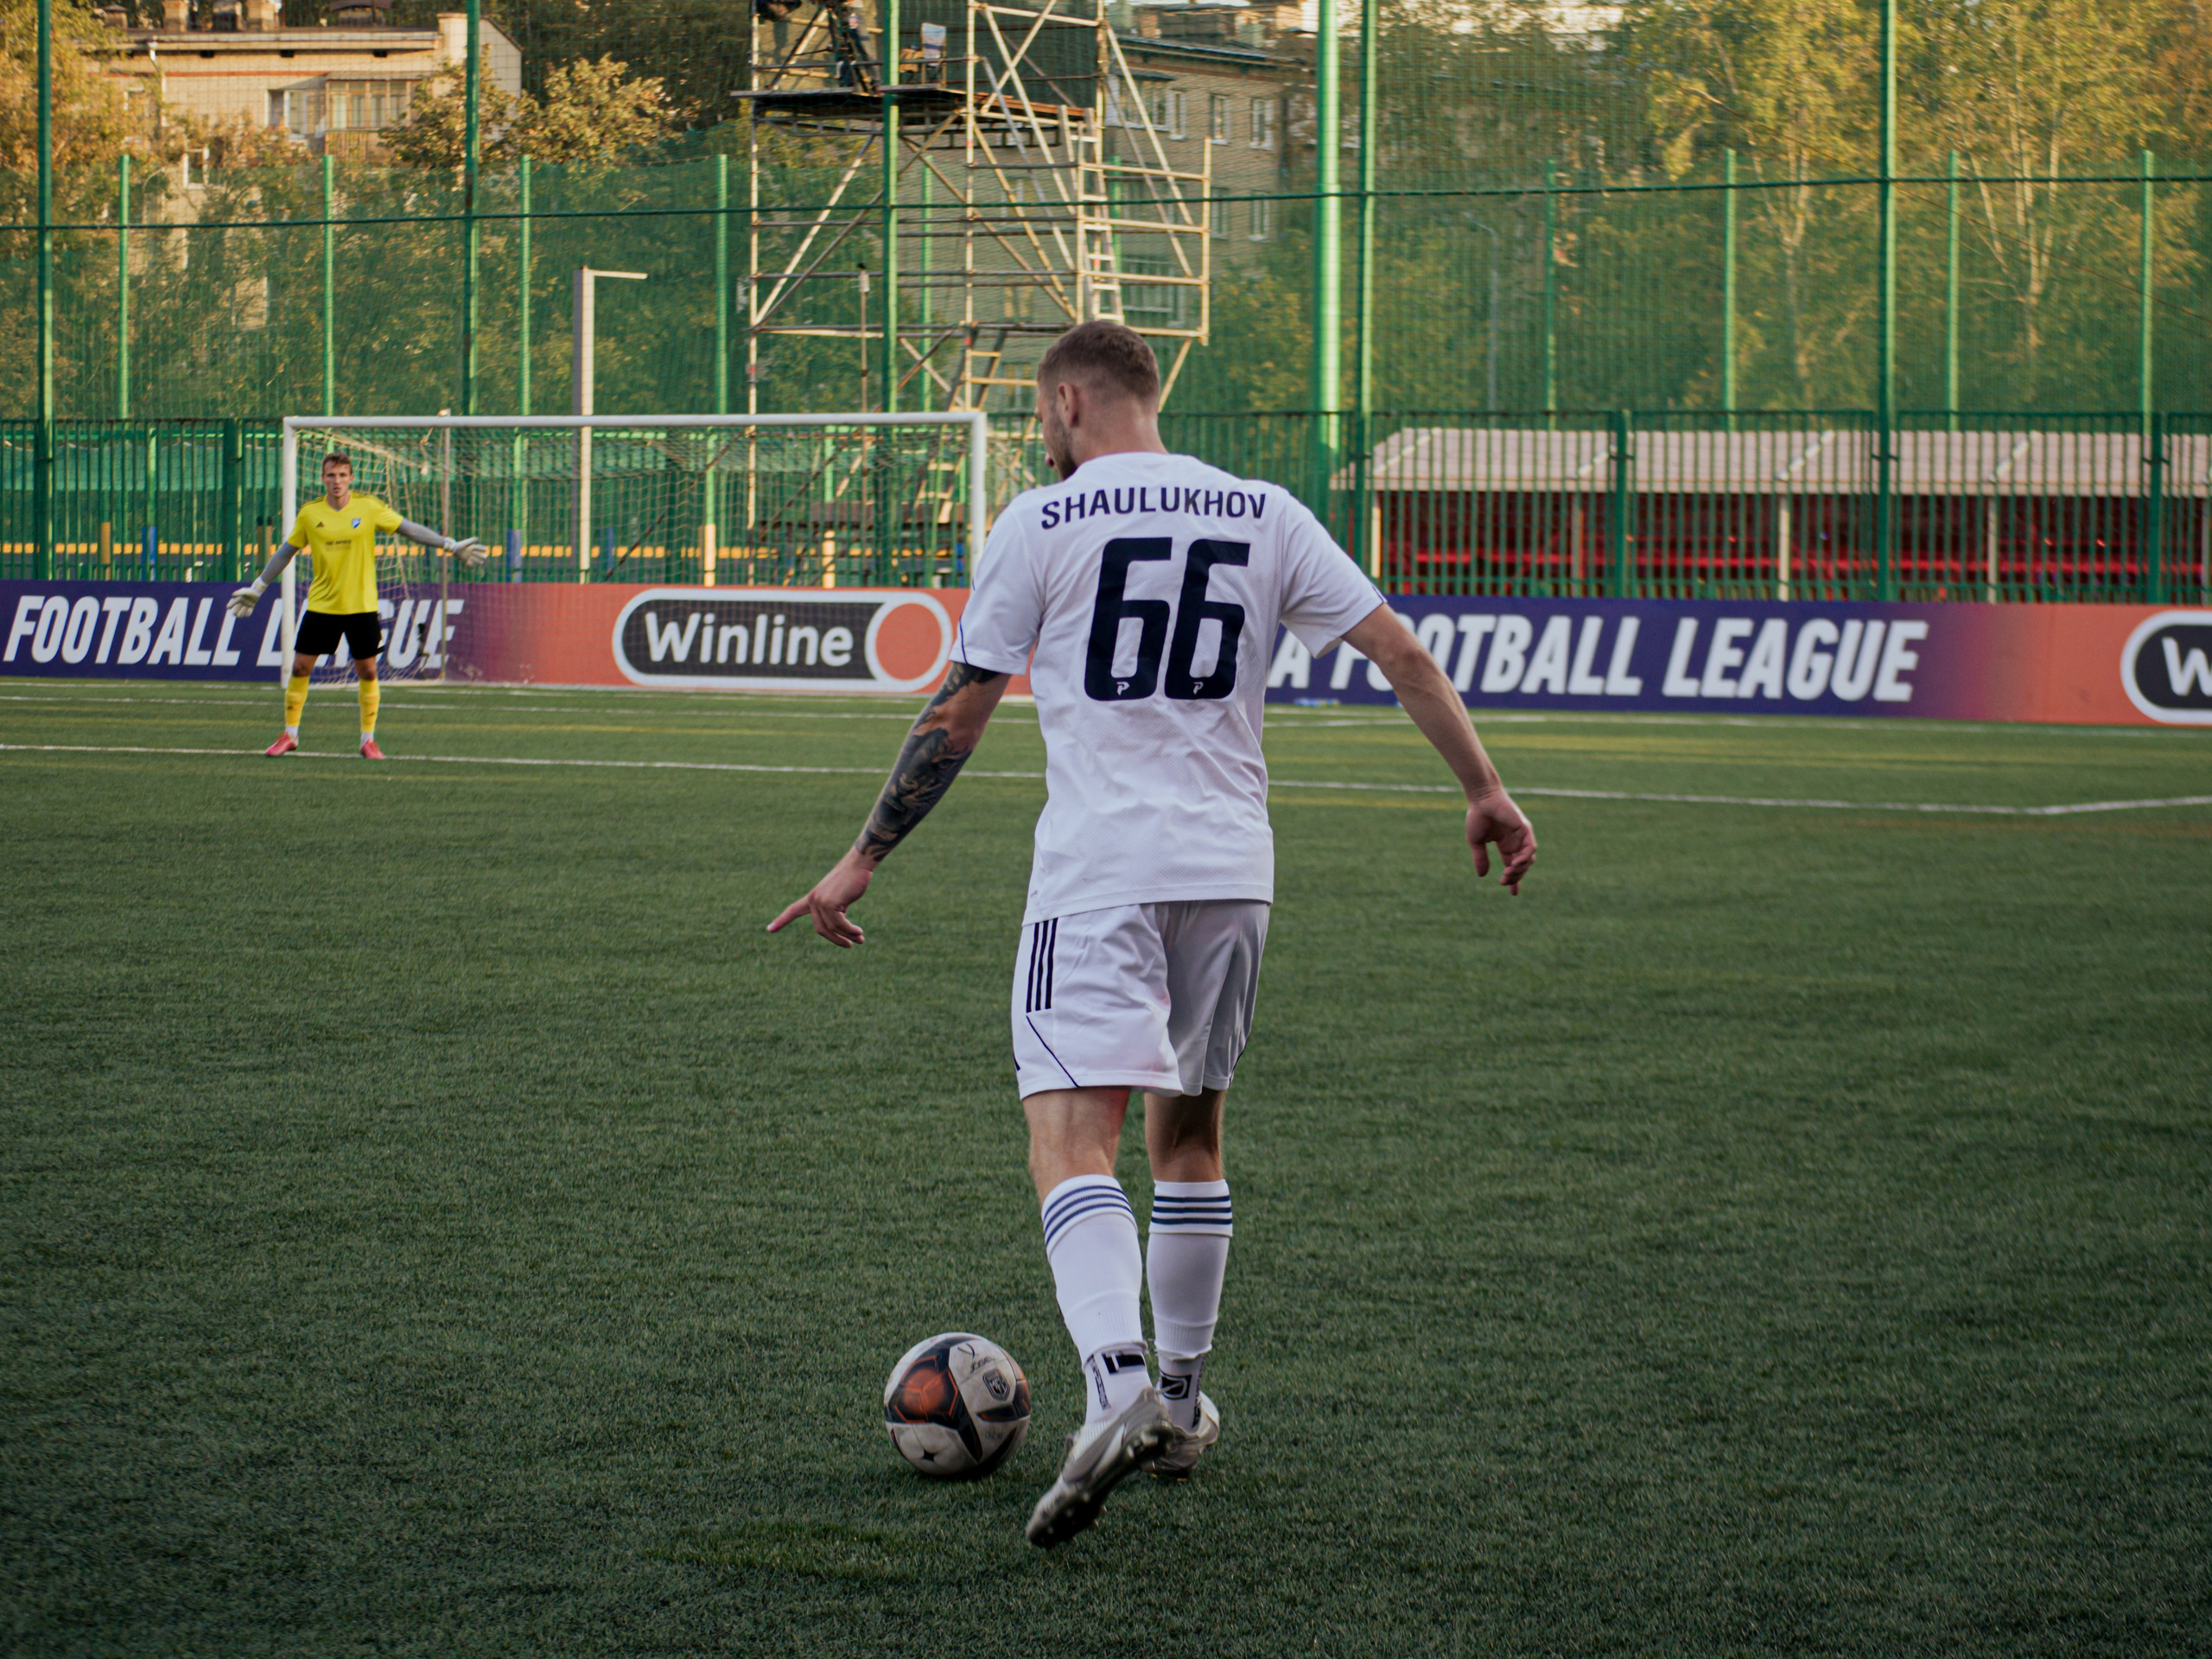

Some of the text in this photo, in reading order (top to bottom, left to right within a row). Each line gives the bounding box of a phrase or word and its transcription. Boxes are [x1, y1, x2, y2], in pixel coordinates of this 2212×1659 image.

[1040, 486, 1266, 530] SHAULUKHOV
[3, 595, 241, 666] FOOTBALL
[645, 612, 854, 667] Winline
[1084, 537, 1251, 702] 66
[1662, 617, 1929, 702] LEAGUE
